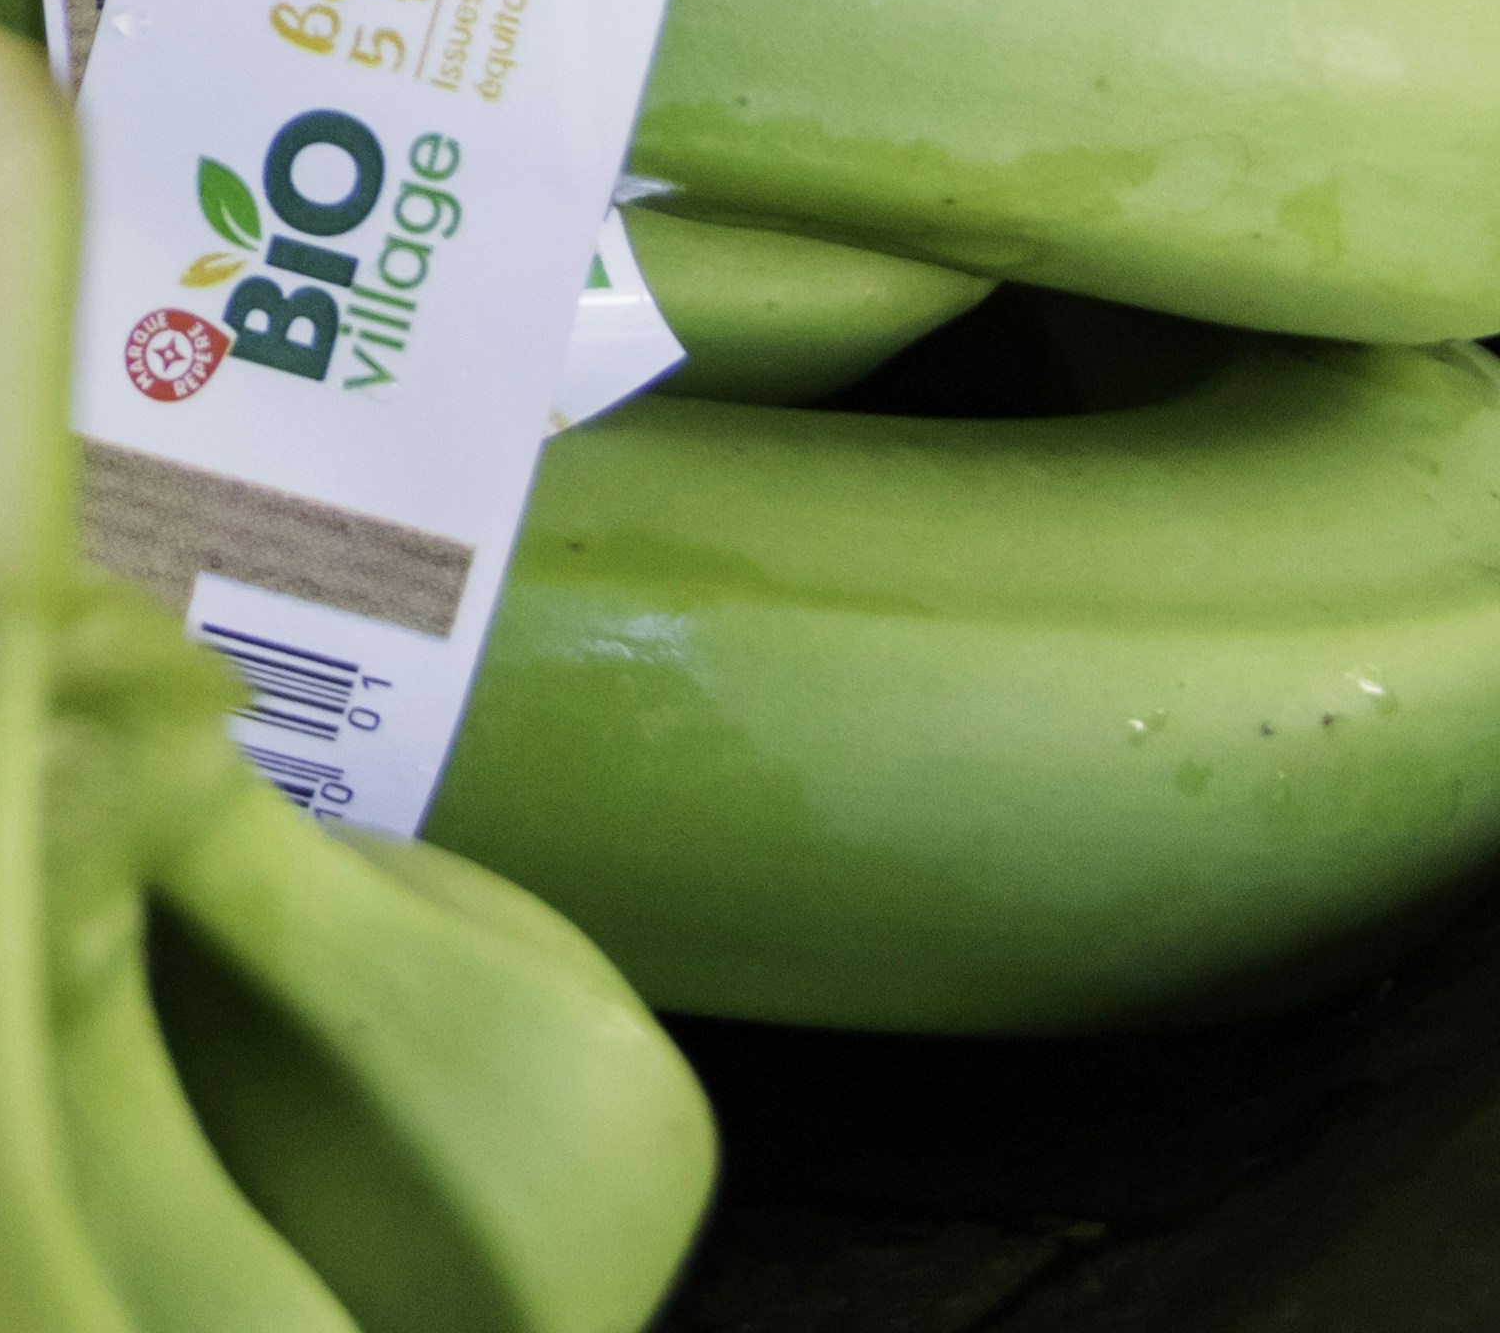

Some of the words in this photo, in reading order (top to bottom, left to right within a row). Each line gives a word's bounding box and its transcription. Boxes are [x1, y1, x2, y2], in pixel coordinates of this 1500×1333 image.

[348, 24, 407, 73] 5
[222, 108, 386, 382] BIO
[341, 131, 462, 391] village
[128, 309, 170, 392] MARQUE
